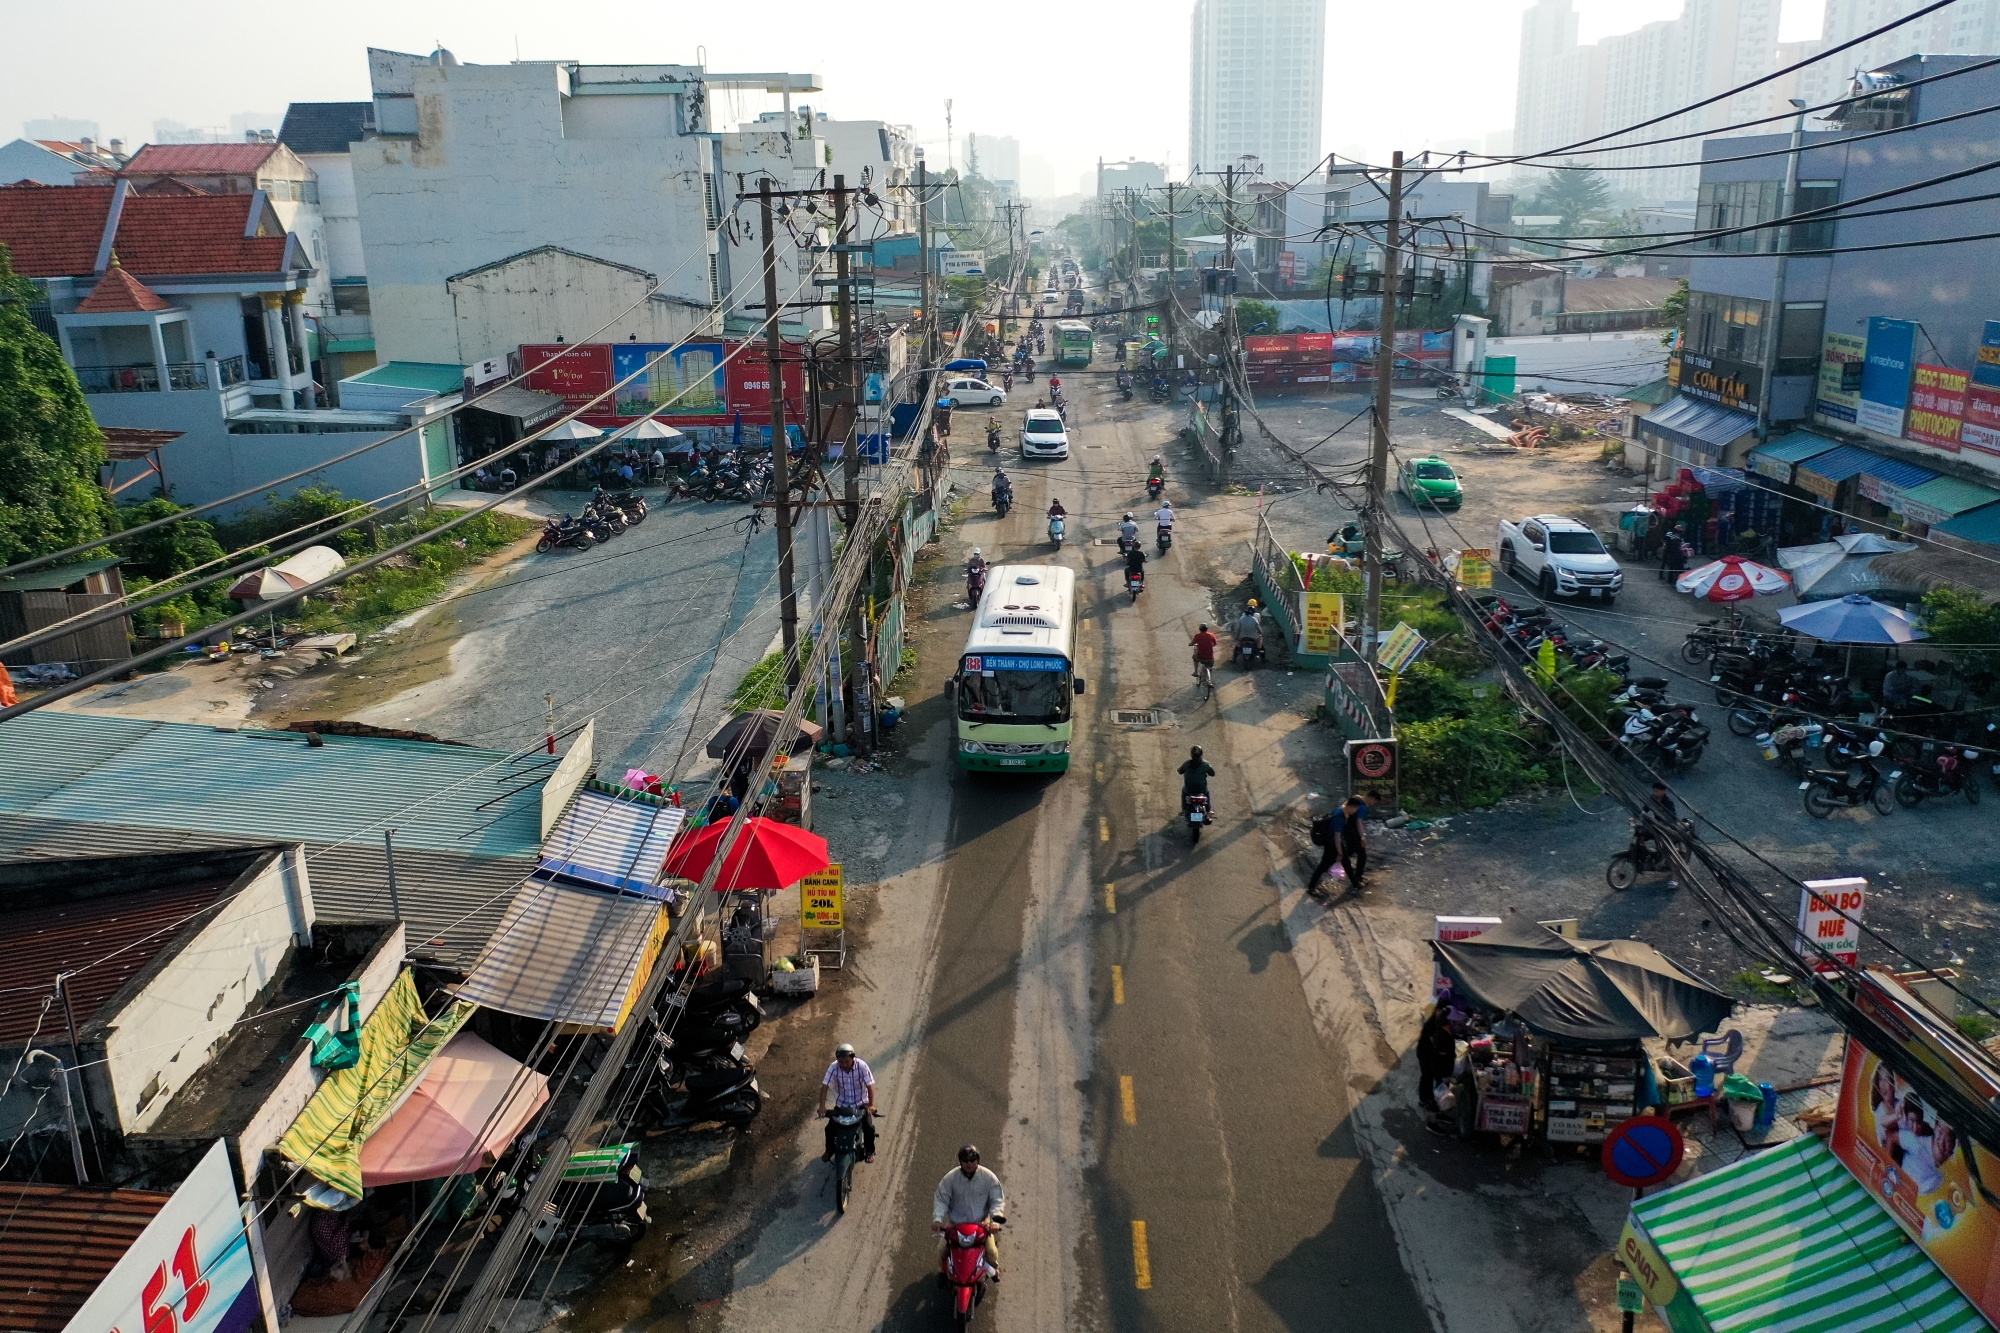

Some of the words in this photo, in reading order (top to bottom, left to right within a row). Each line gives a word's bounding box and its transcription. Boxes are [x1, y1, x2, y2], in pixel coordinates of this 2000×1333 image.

[1869, 352, 1905, 370] vinaphone
[1693, 370, 1718, 391] CƠM
[1939, 372, 1967, 393] TRANG
[1909, 408, 1961, 440] PHOTOCOPY
[966, 658, 981, 670] 88
[986, 657, 997, 668] BẾN
[997, 658, 1015, 668] THÀNH
[1019, 660, 1029, 670] CHỢ
[1030, 660, 1044, 669] LONG
[1045, 659, 1062, 669] PHƯỚC
[805, 877, 820, 886] BÁNH
[811, 899, 834, 908] 20k
[1809, 890, 1838, 913] BÚN
[1840, 888, 1862, 911] BÒ
[1836, 938, 1855, 950] GỐC
[1626, 1238, 1659, 1290] ENAT
